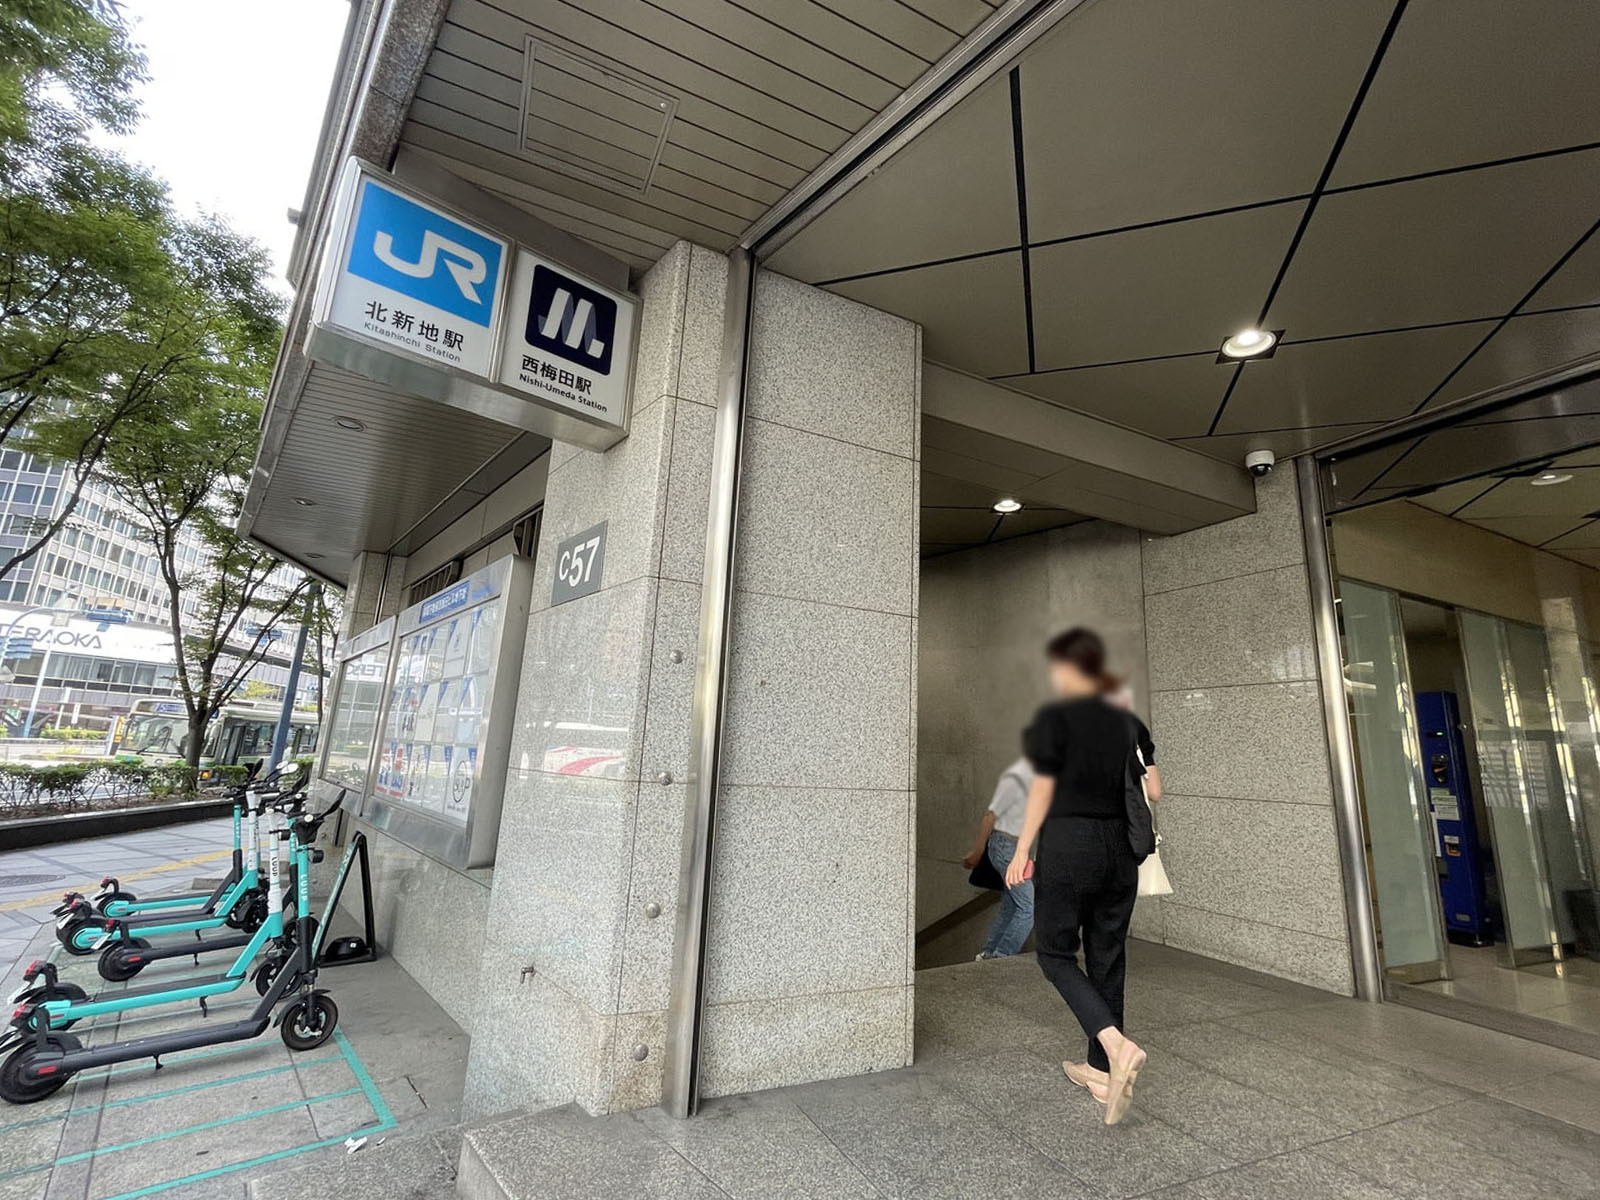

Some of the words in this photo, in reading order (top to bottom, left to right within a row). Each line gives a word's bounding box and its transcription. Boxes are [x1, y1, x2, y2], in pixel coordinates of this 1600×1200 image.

[374, 230, 486, 305] JR
[364, 321, 421, 348] Kitashinchi
[425, 344, 461, 363] Station
[365, 301, 464, 351] 北新地駅
[519, 373, 576, 400] Nishi-Umeda
[578, 395, 608, 413] Station
[522, 354, 592, 395] 西梅田駅
[559, 535, 600, 587] C57
[300, 873, 308, 902] LUUP
